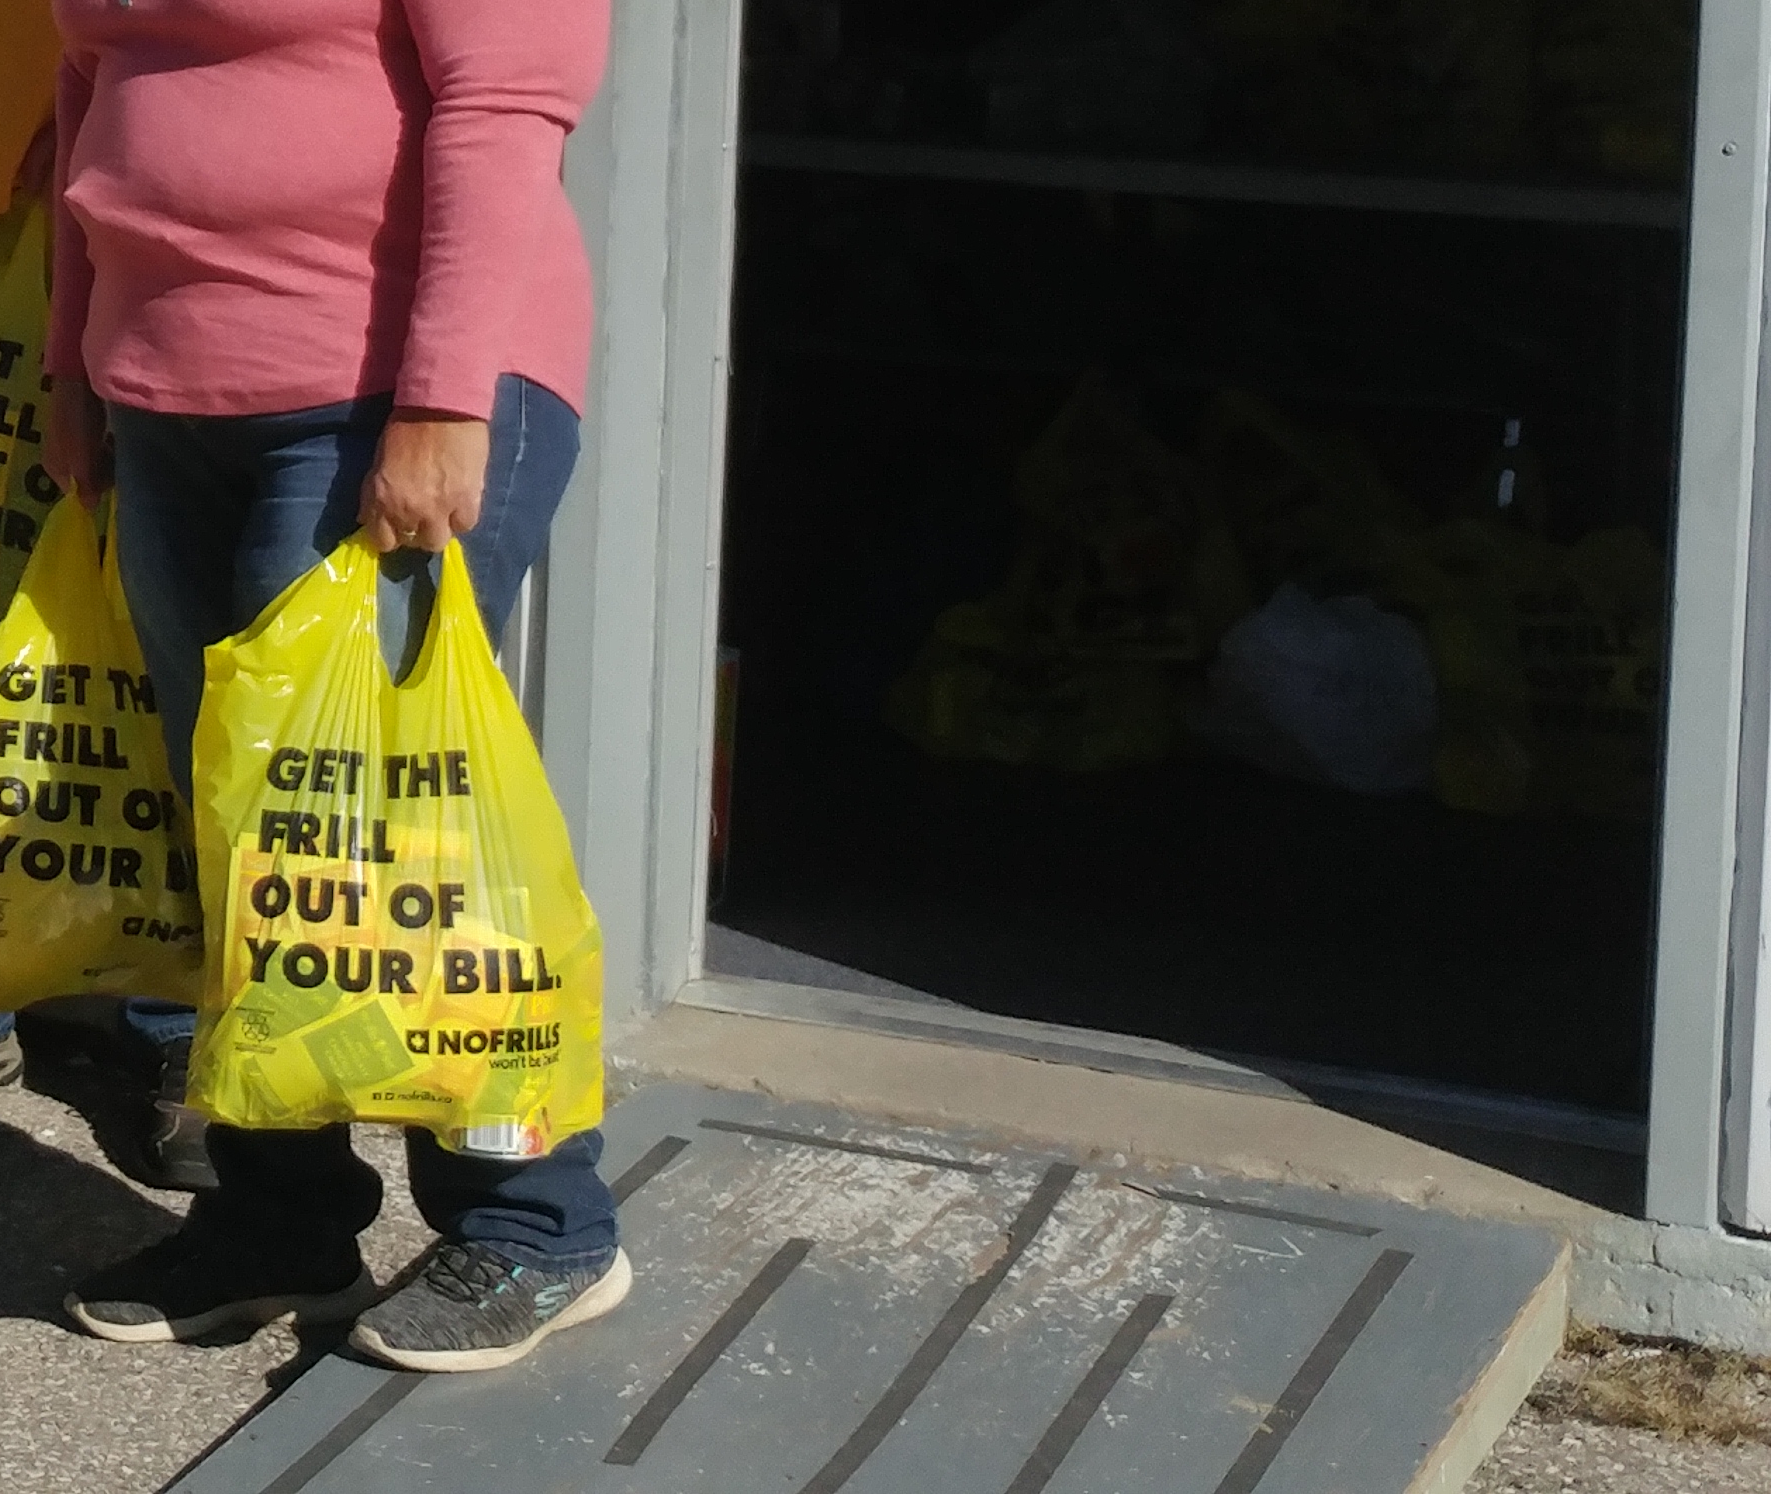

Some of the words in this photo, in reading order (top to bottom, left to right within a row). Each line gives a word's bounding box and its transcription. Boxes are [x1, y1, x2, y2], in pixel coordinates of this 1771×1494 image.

[266, 746, 365, 795] GET
[382, 748, 472, 799] THE
[258, 808, 396, 864] FRILL
[250, 873, 368, 927] OUT
[389, 882, 465, 929] OF
[244, 936, 417, 994] YOUR
[442, 945, 563, 994] BILL.
[438, 1021, 561, 1055] NOFRILLS
[489, 1055, 526, 1070] won't
